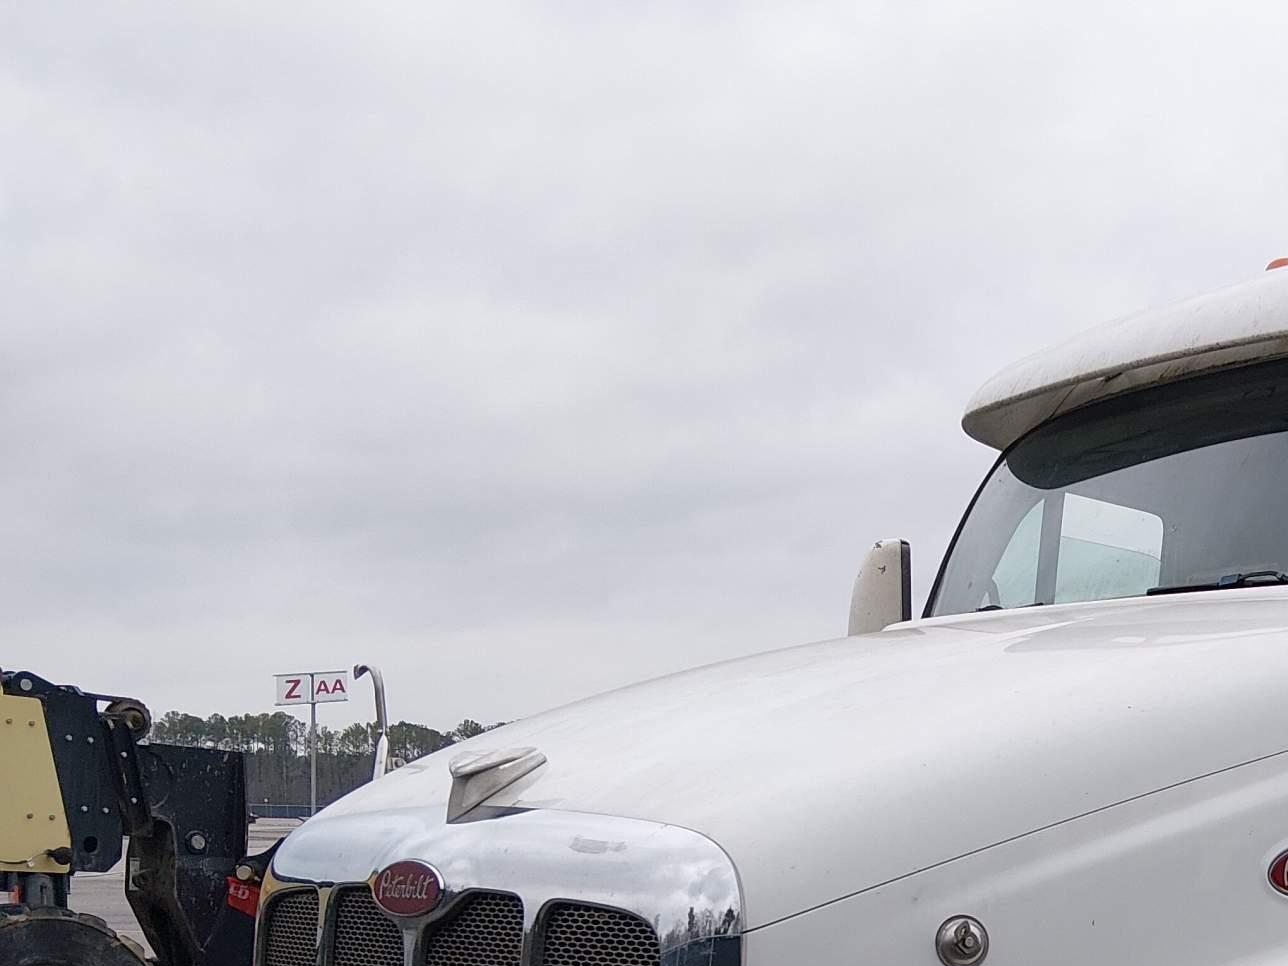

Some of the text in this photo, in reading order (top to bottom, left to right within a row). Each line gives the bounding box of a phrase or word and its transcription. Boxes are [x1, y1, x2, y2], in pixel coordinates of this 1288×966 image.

[284, 680, 302, 699] Z
[316, 679, 346, 695] AA
[379, 870, 434, 900] Peterbilt
